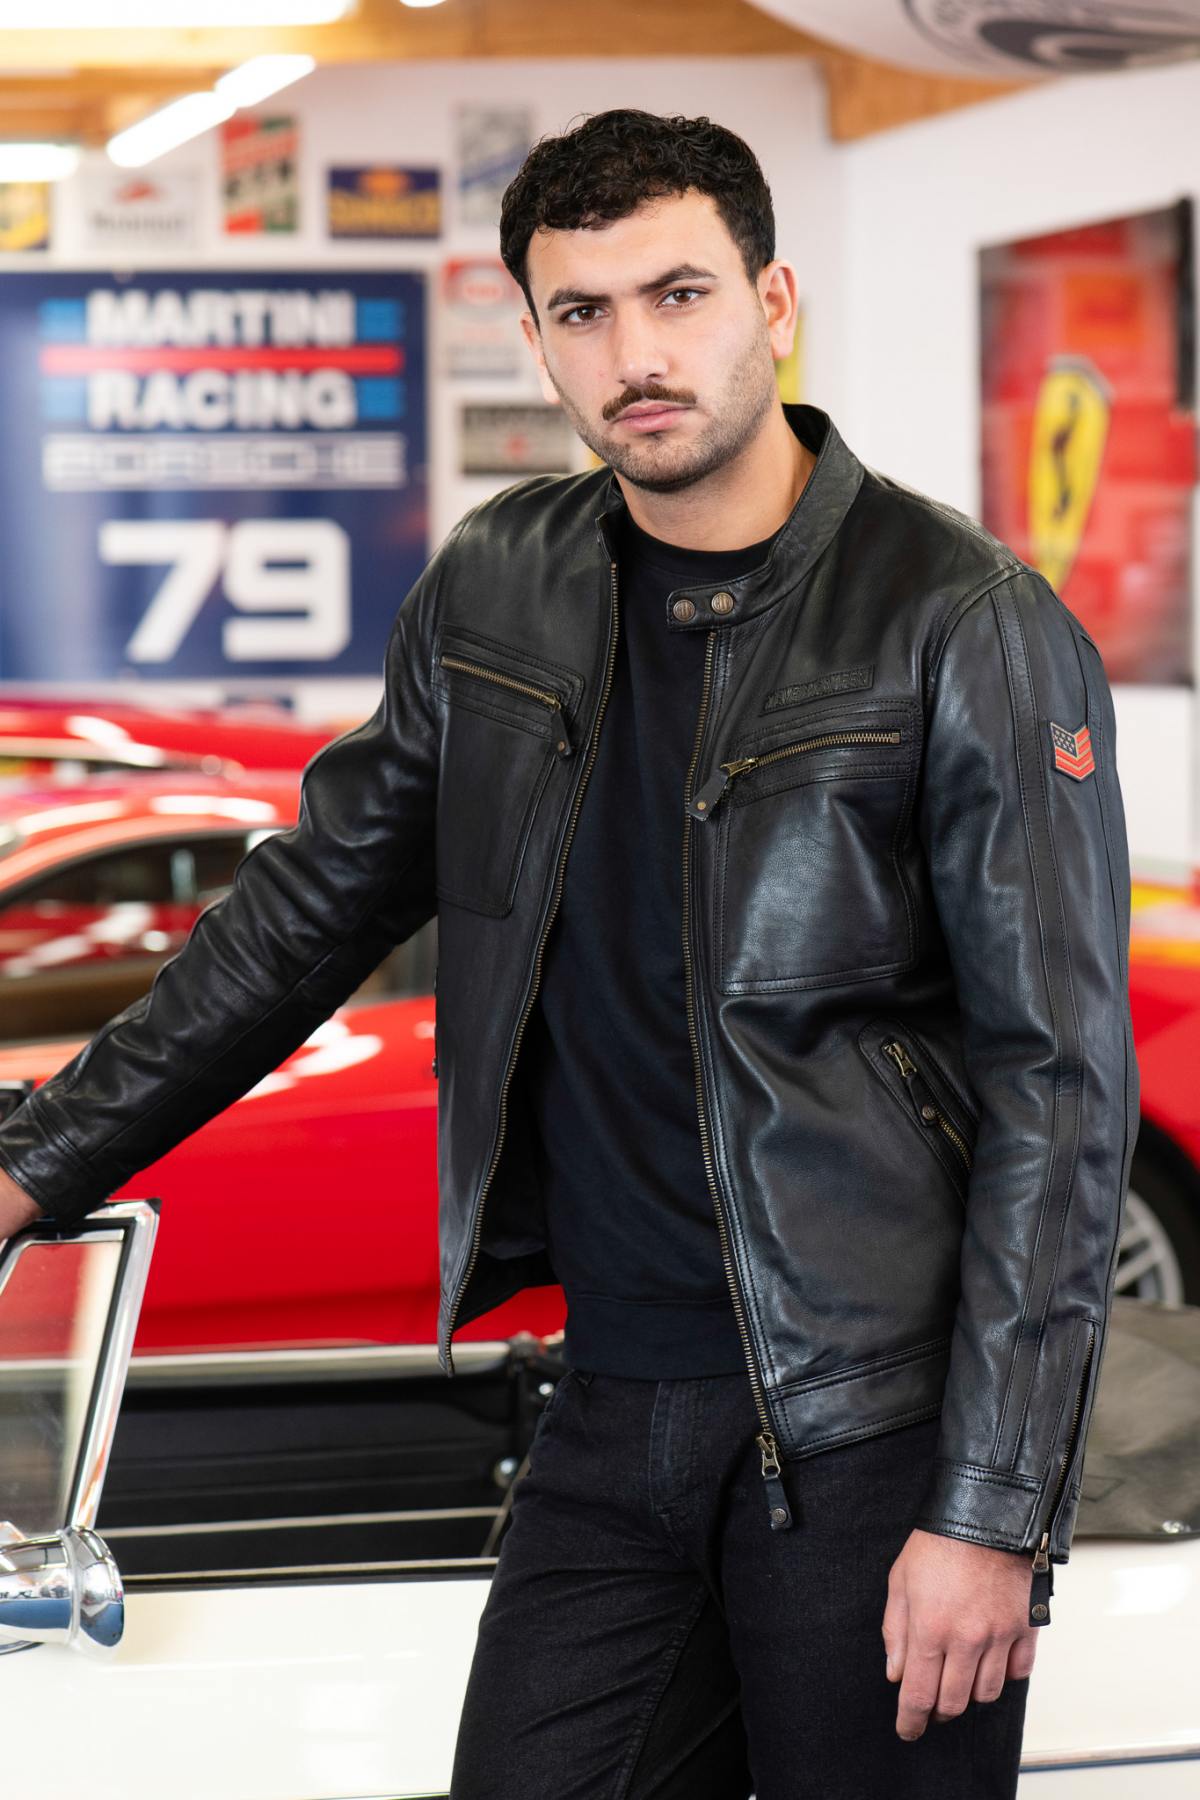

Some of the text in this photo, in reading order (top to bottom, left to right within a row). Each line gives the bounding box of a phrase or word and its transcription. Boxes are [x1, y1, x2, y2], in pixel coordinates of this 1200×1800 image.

[86, 290, 354, 348] MARTINI
[86, 371, 356, 430] RACING
[98, 520, 350, 664] 79
